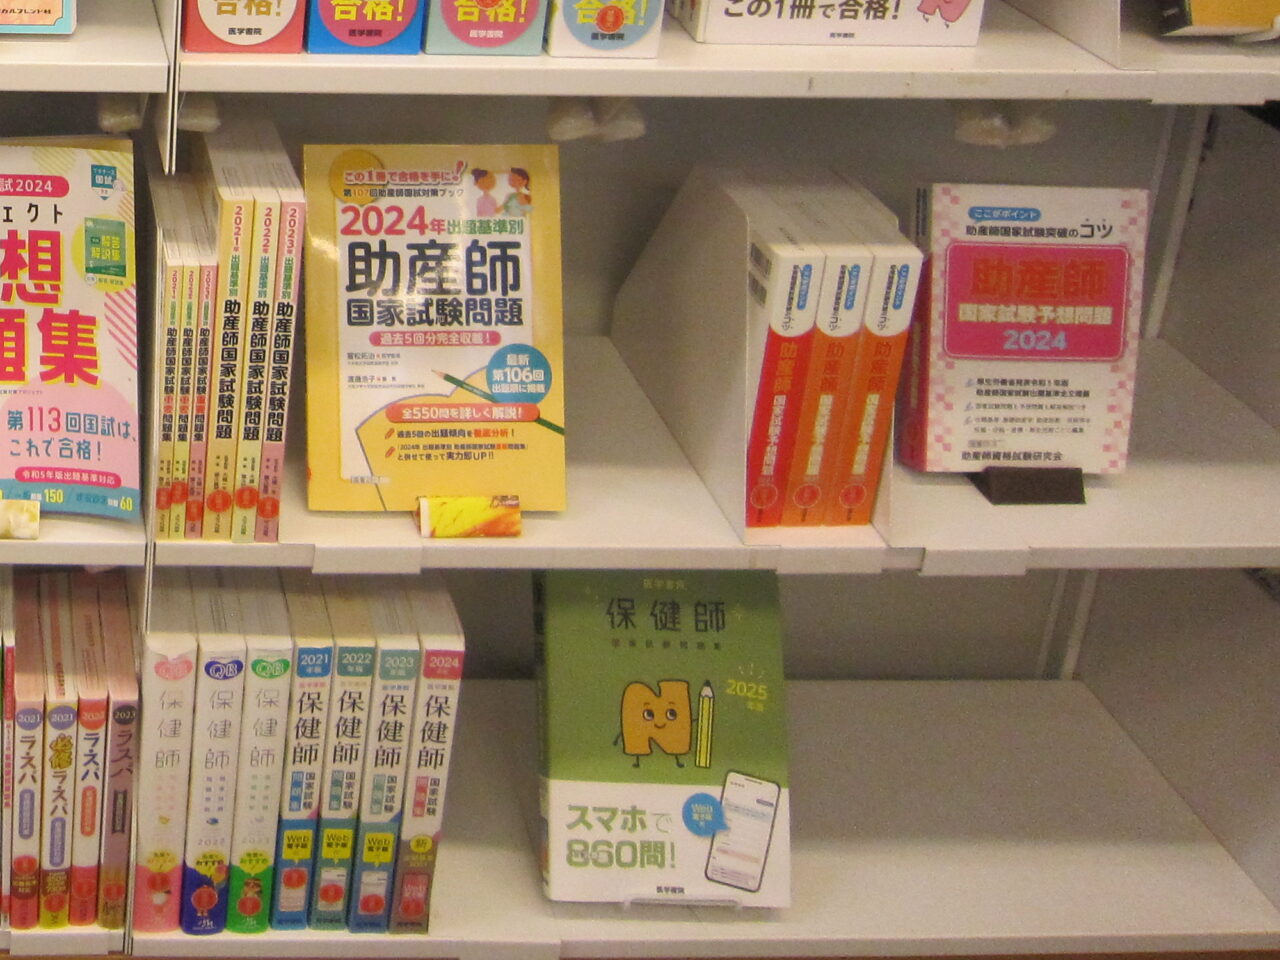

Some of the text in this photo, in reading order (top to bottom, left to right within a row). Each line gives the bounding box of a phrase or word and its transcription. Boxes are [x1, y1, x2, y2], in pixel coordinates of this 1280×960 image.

[346, 239, 522, 297] 助産師
[346, 298, 524, 327] 国家試験問題
[1004, 330, 1067, 350] 2024
[216, 299, 241, 439] 助産師国家試験問題
[243, 301, 270, 440] 助産師国家試験問題
[266, 302, 294, 441] 助産師国家試験問題
[493, 367, 544, 383] 第106回
[506, 354, 530, 366] 最新
[7, 406, 136, 442] 第113回国試は、
[10, 438, 102, 461] これで合格!
[607, 597, 726, 634] 保健師
[300, 653, 329, 665] 2021
[385, 656, 414, 668] 2023
[429, 656, 460, 668] 2024
[726, 679, 768, 700] 2025
[292, 691, 324, 766] 保健師
[332, 690, 365, 765] 保健師
[373, 694, 407, 769] 保健師
[417, 695, 451, 770] 保健師
[565, 805, 674, 834] スマホで
[566, 839, 677, 869] 860問!
